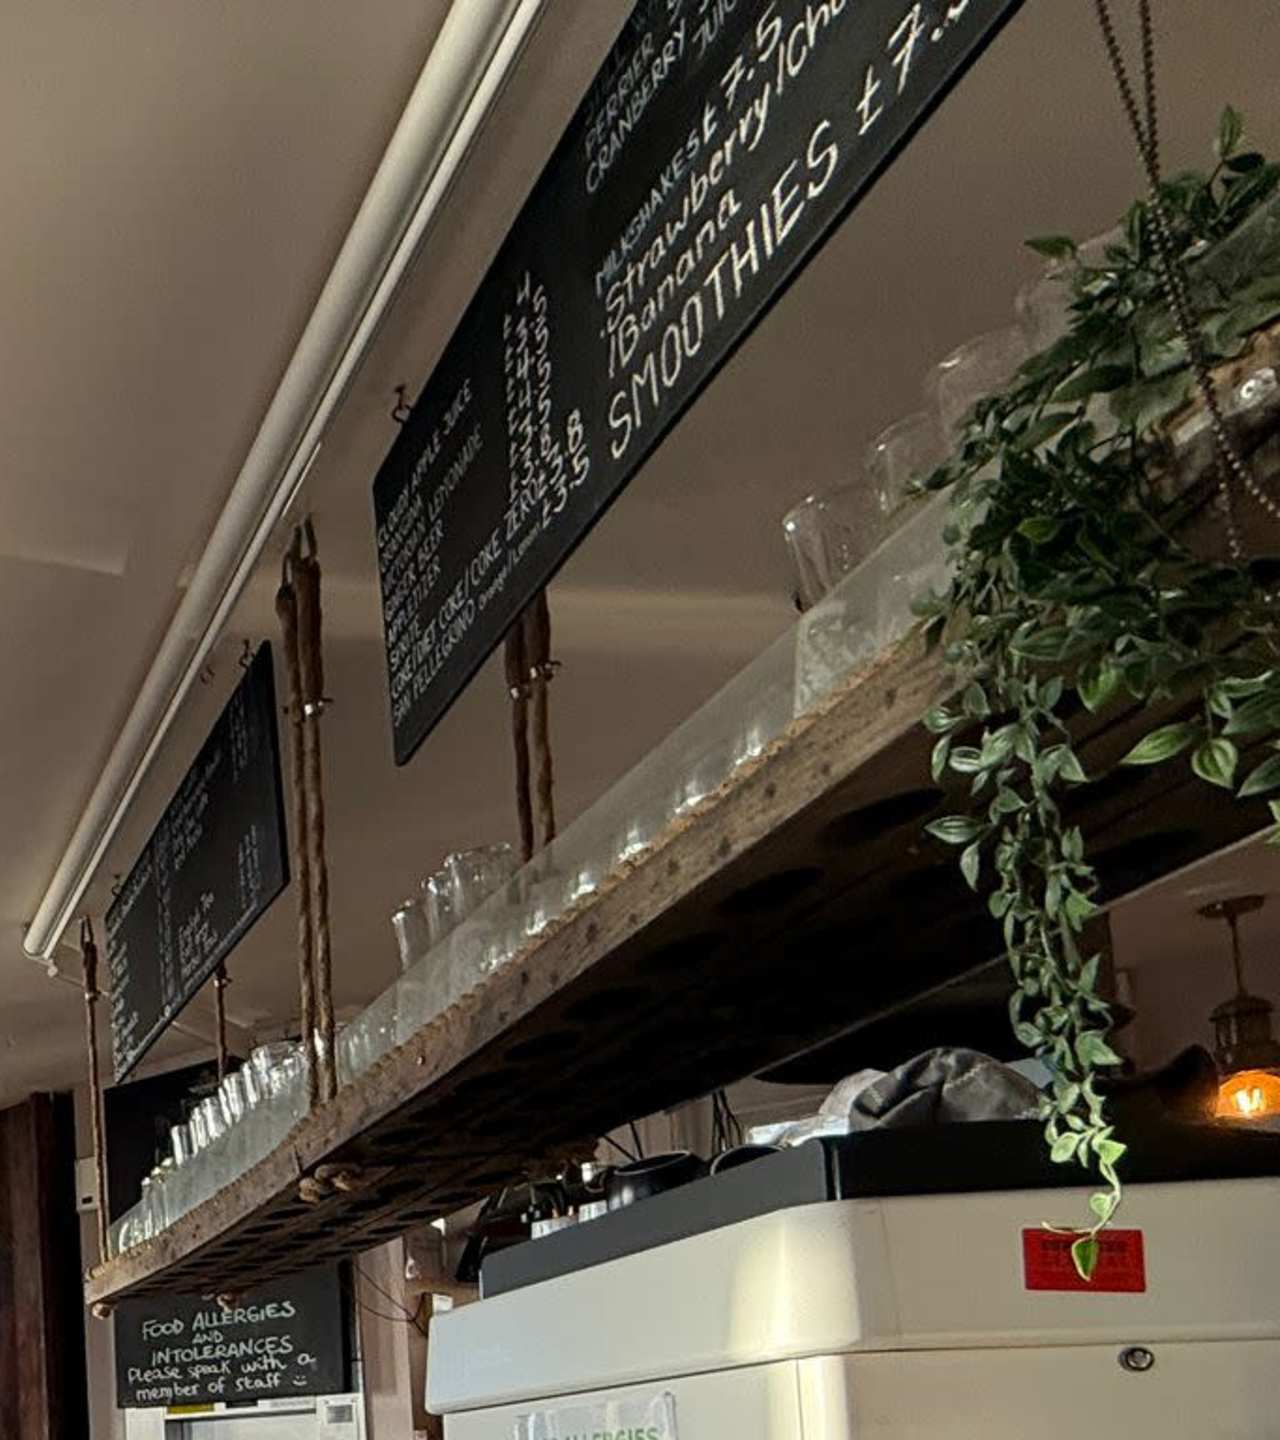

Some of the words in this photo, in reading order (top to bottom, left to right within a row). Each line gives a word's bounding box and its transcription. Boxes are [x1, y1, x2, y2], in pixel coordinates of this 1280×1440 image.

[586, 18, 686, 195] CRANBERRY
[609, 120, 837, 458] SMOOTHIES
[417, 519, 444, 573] BEER
[142, 1319, 184, 1340] FOOD
[192, 1300, 296, 1331] ALLERGIES
[192, 1330, 224, 1344] AND
[151, 1335, 294, 1367] INTOLERANCES
[241, 1354, 287, 1374] with
[136, 1383, 199, 1401] member
[207, 1376, 225, 1394] of
[235, 1371, 280, 1392] staff
